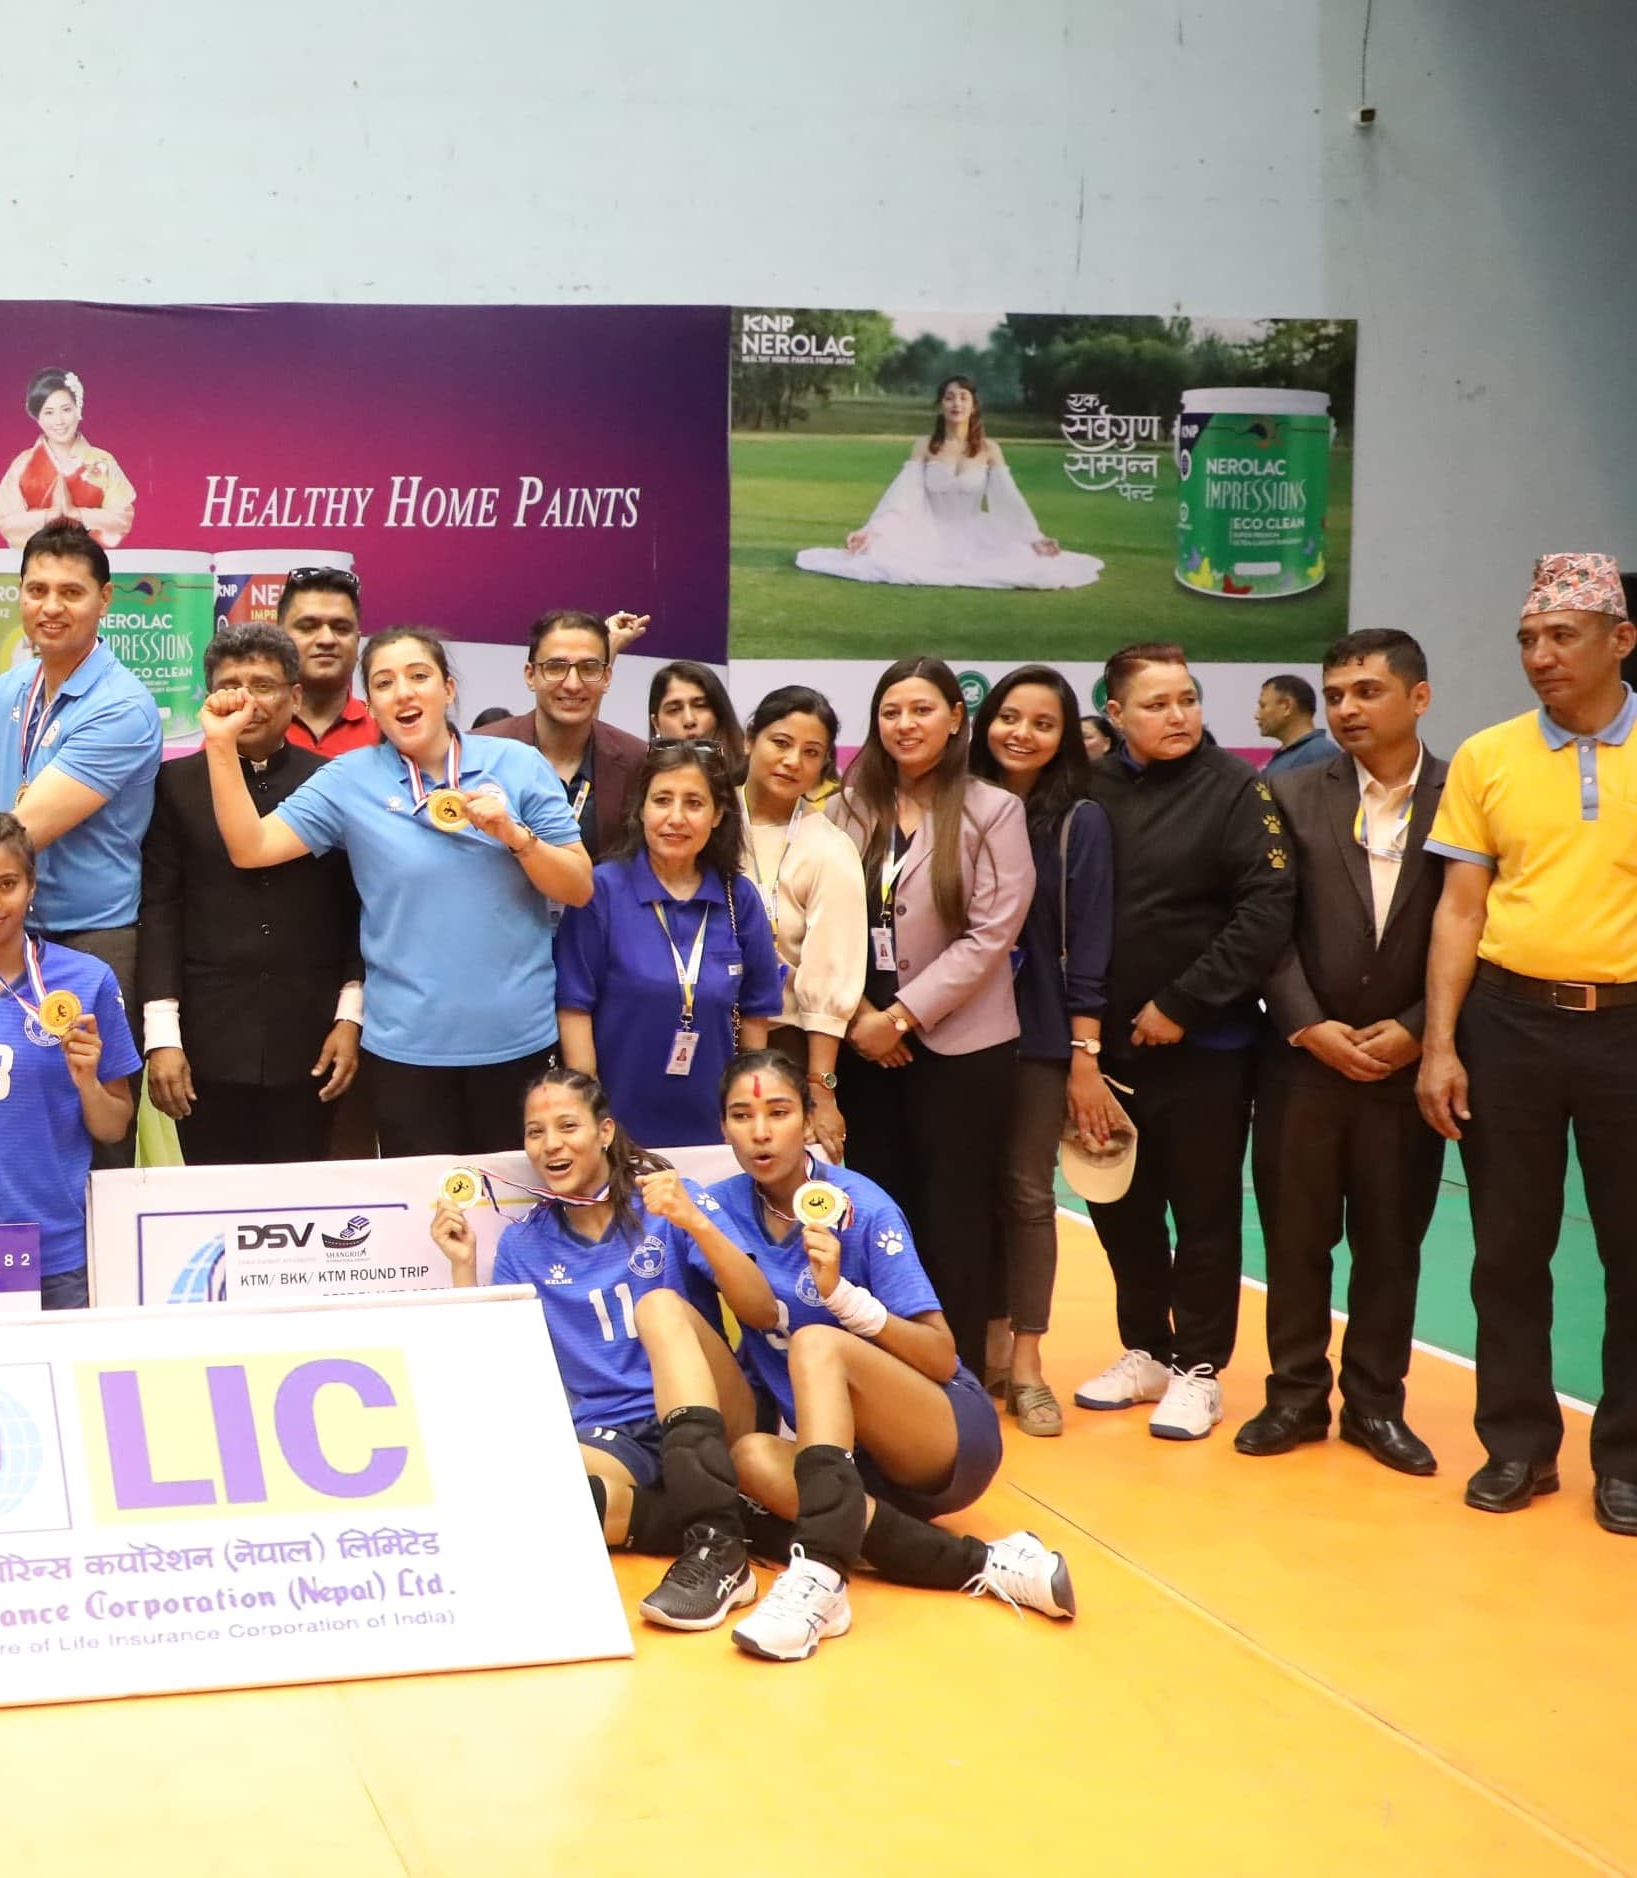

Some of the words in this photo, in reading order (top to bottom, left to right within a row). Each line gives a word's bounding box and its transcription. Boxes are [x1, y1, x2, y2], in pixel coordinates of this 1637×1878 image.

[743, 314, 794, 332] KNP
[742, 333, 856, 356] NEROLAC
[1061, 405, 1160, 451] सर्वगुण
[1064, 454, 1160, 490] सम्पन्न
[1206, 459, 1286, 476] NEROLAC
[200, 475, 374, 527] HEALTHY
[384, 475, 499, 527] HOME
[513, 475, 640, 528] PAINTS
[1205, 478, 1308, 514] IMPRESSIONS
[1234, 518, 1263, 530] ECO
[1266, 517, 1305, 530] CLEAN
[155, 666, 193, 679] CLEAN
[237, 1222, 315, 1250] DSV
[241, 1273, 275, 1287] KTM/
[280, 1271, 314, 1286] BKK/
[318, 1270, 346, 1283] KTM
[350, 1267, 396, 1281] ROUND
[400, 1265, 429, 1278] TRIP
[544, 1278, 573, 1286] KELME
[589, 1283, 639, 1342] 11
[98, 1358, 409, 1511] LIC
[224, 1532, 325, 1572] (नेपाल)
[336, 1527, 440, 1559] लिमिटेड
[85, 1590, 276, 1620] Corporation
[289, 1570, 386, 1610] (Nepal)
[398, 1567, 456, 1597] Ltd.
[30, 1637, 50, 1653] of
[59, 1634, 100, 1651] Life
[109, 1630, 220, 1648] Insurance
[229, 1614, 359, 1639] Corporation
[366, 1611, 387, 1628] of
[394, 1608, 456, 1627] India)
